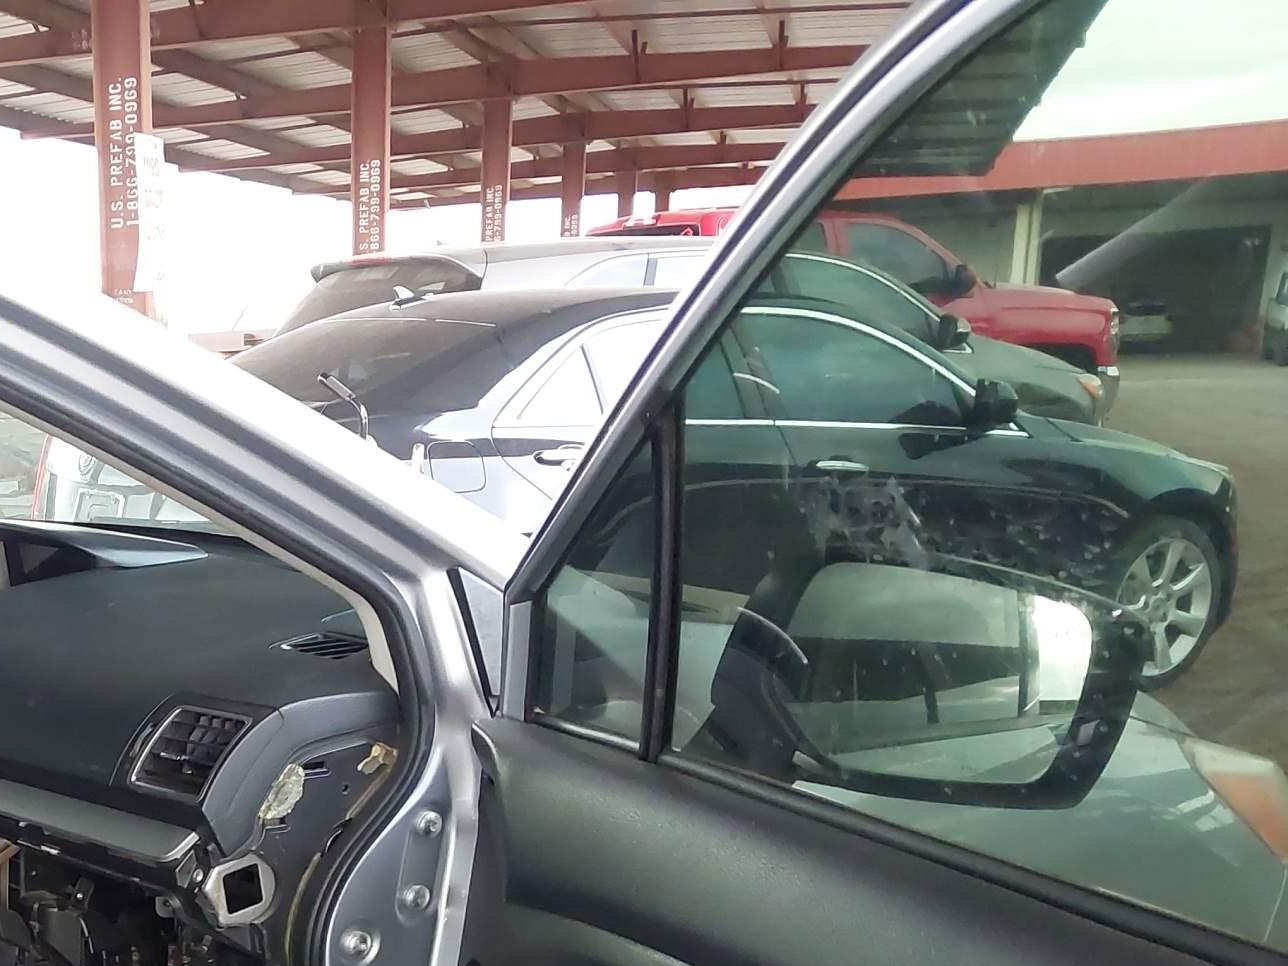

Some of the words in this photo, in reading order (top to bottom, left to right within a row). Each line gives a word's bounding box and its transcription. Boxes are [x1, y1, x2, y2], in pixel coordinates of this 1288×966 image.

[108, 76, 123, 111] INC.
[109, 119, 124, 186] PREFAB
[124, 77, 140, 227] 1-866-799-0969
[359, 159, 370, 183] INC.
[110, 195, 124, 229] U.S.
[359, 187, 370, 234] PREFAB
